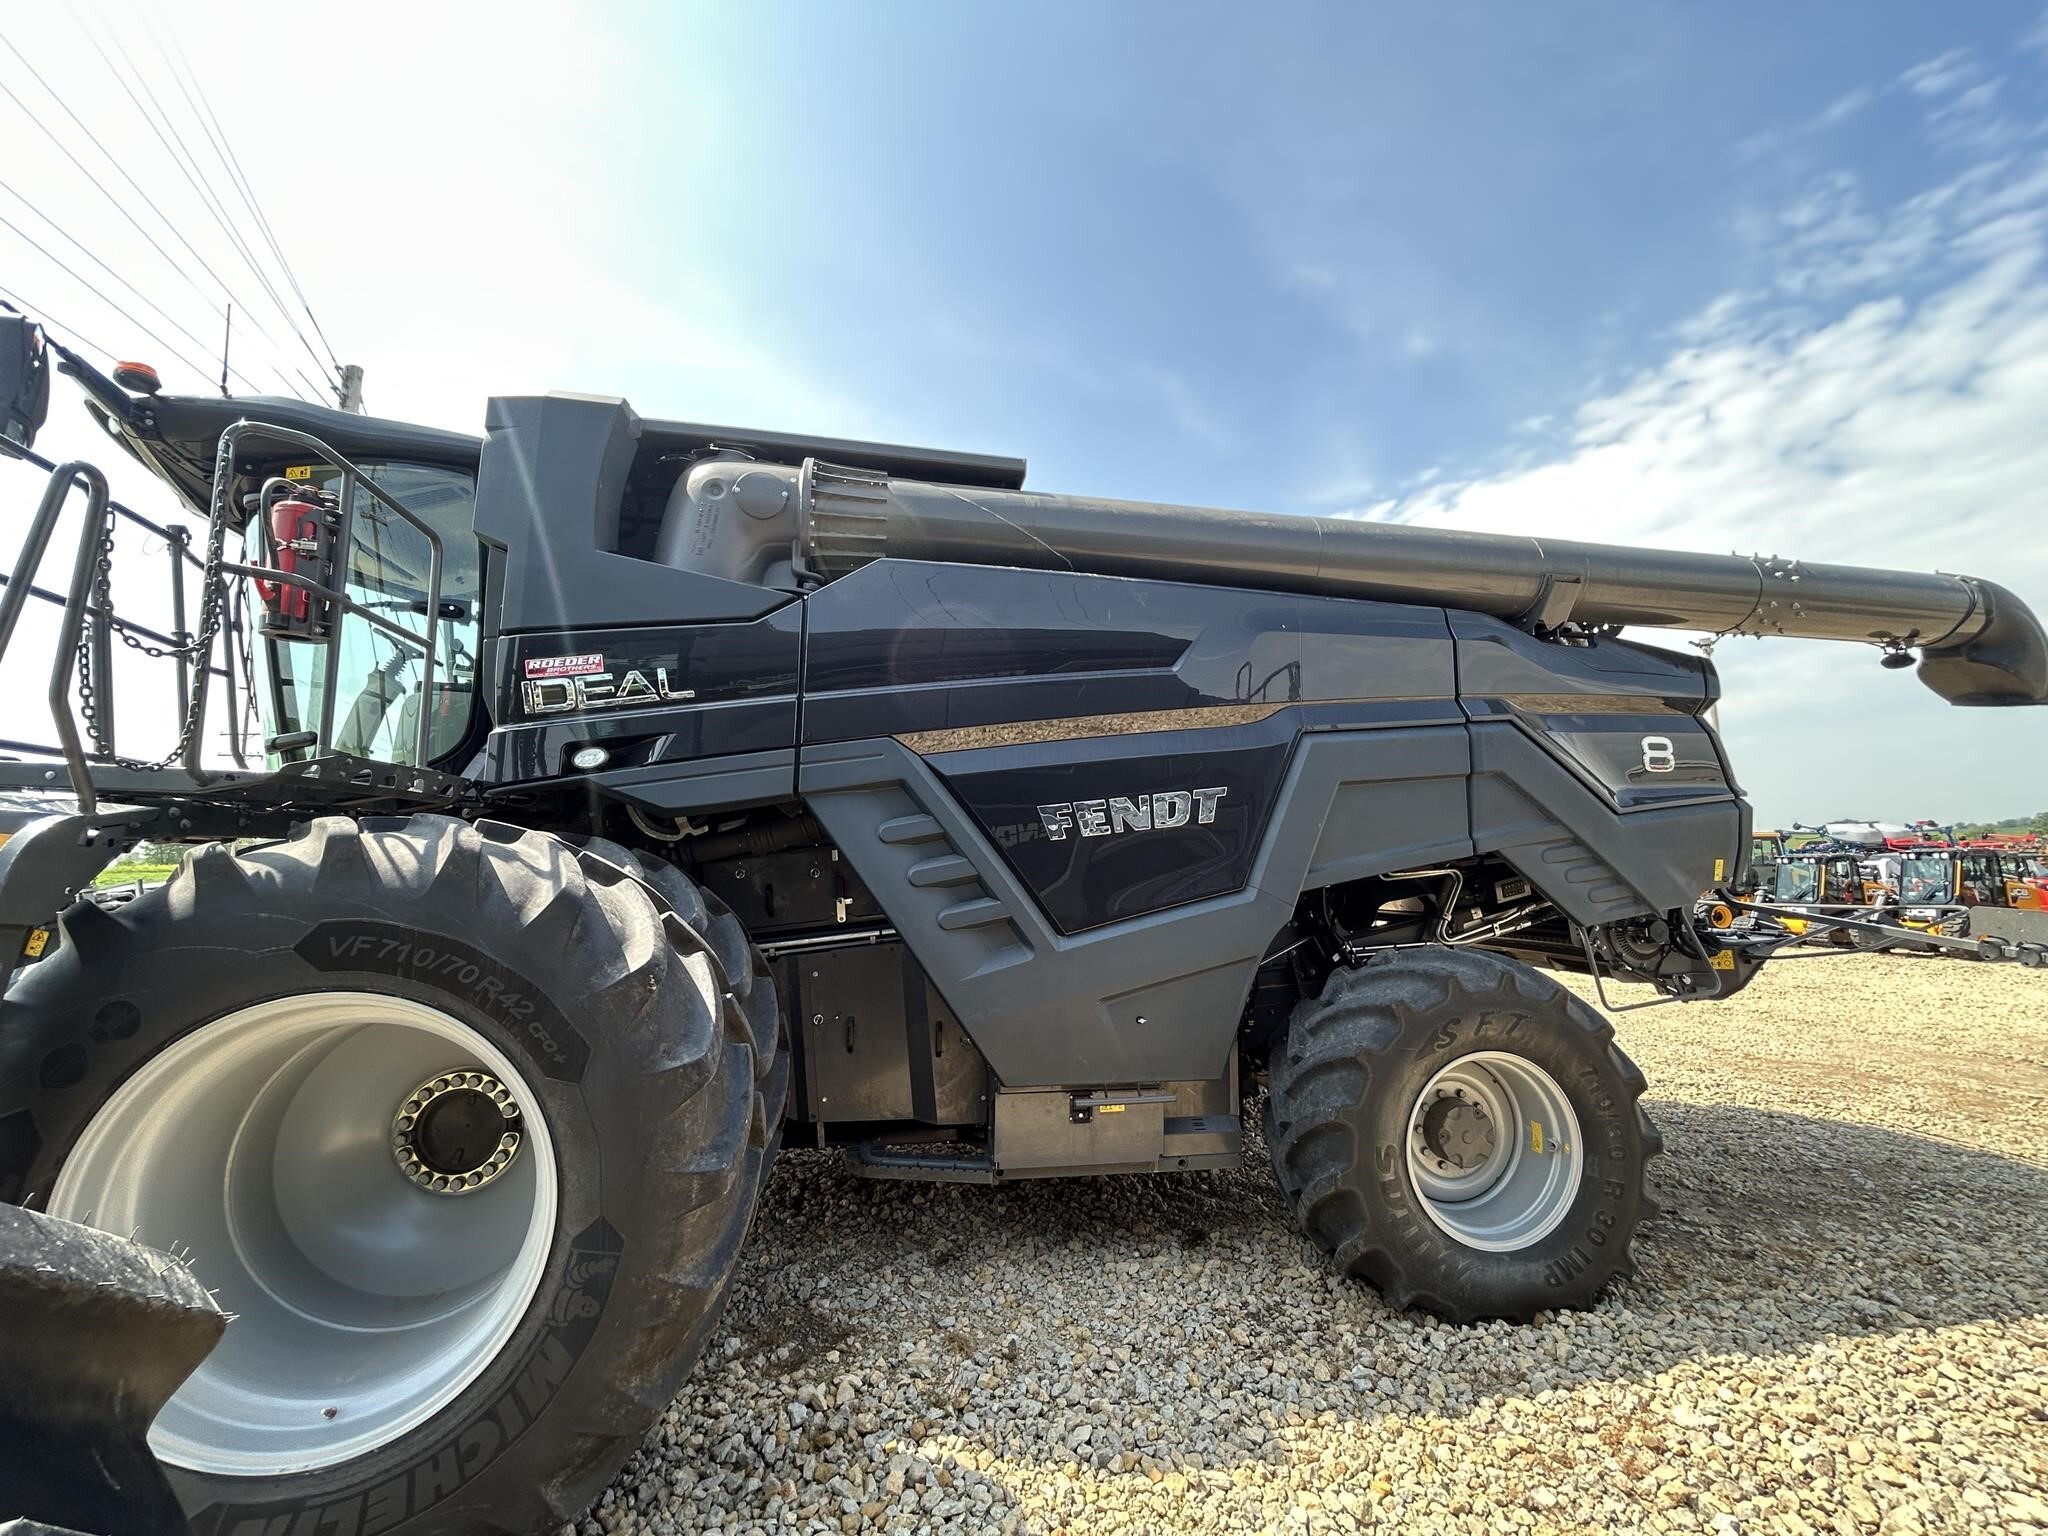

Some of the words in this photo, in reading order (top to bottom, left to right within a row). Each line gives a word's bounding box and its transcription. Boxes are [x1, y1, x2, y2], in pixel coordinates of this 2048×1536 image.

[528, 655, 601, 669] ROEDER
[546, 665, 597, 673] BROTHERS
[521, 667, 695, 715] IDEAL
[1641, 736, 1675, 772] 8
[1037, 786, 1228, 841] FENDT
